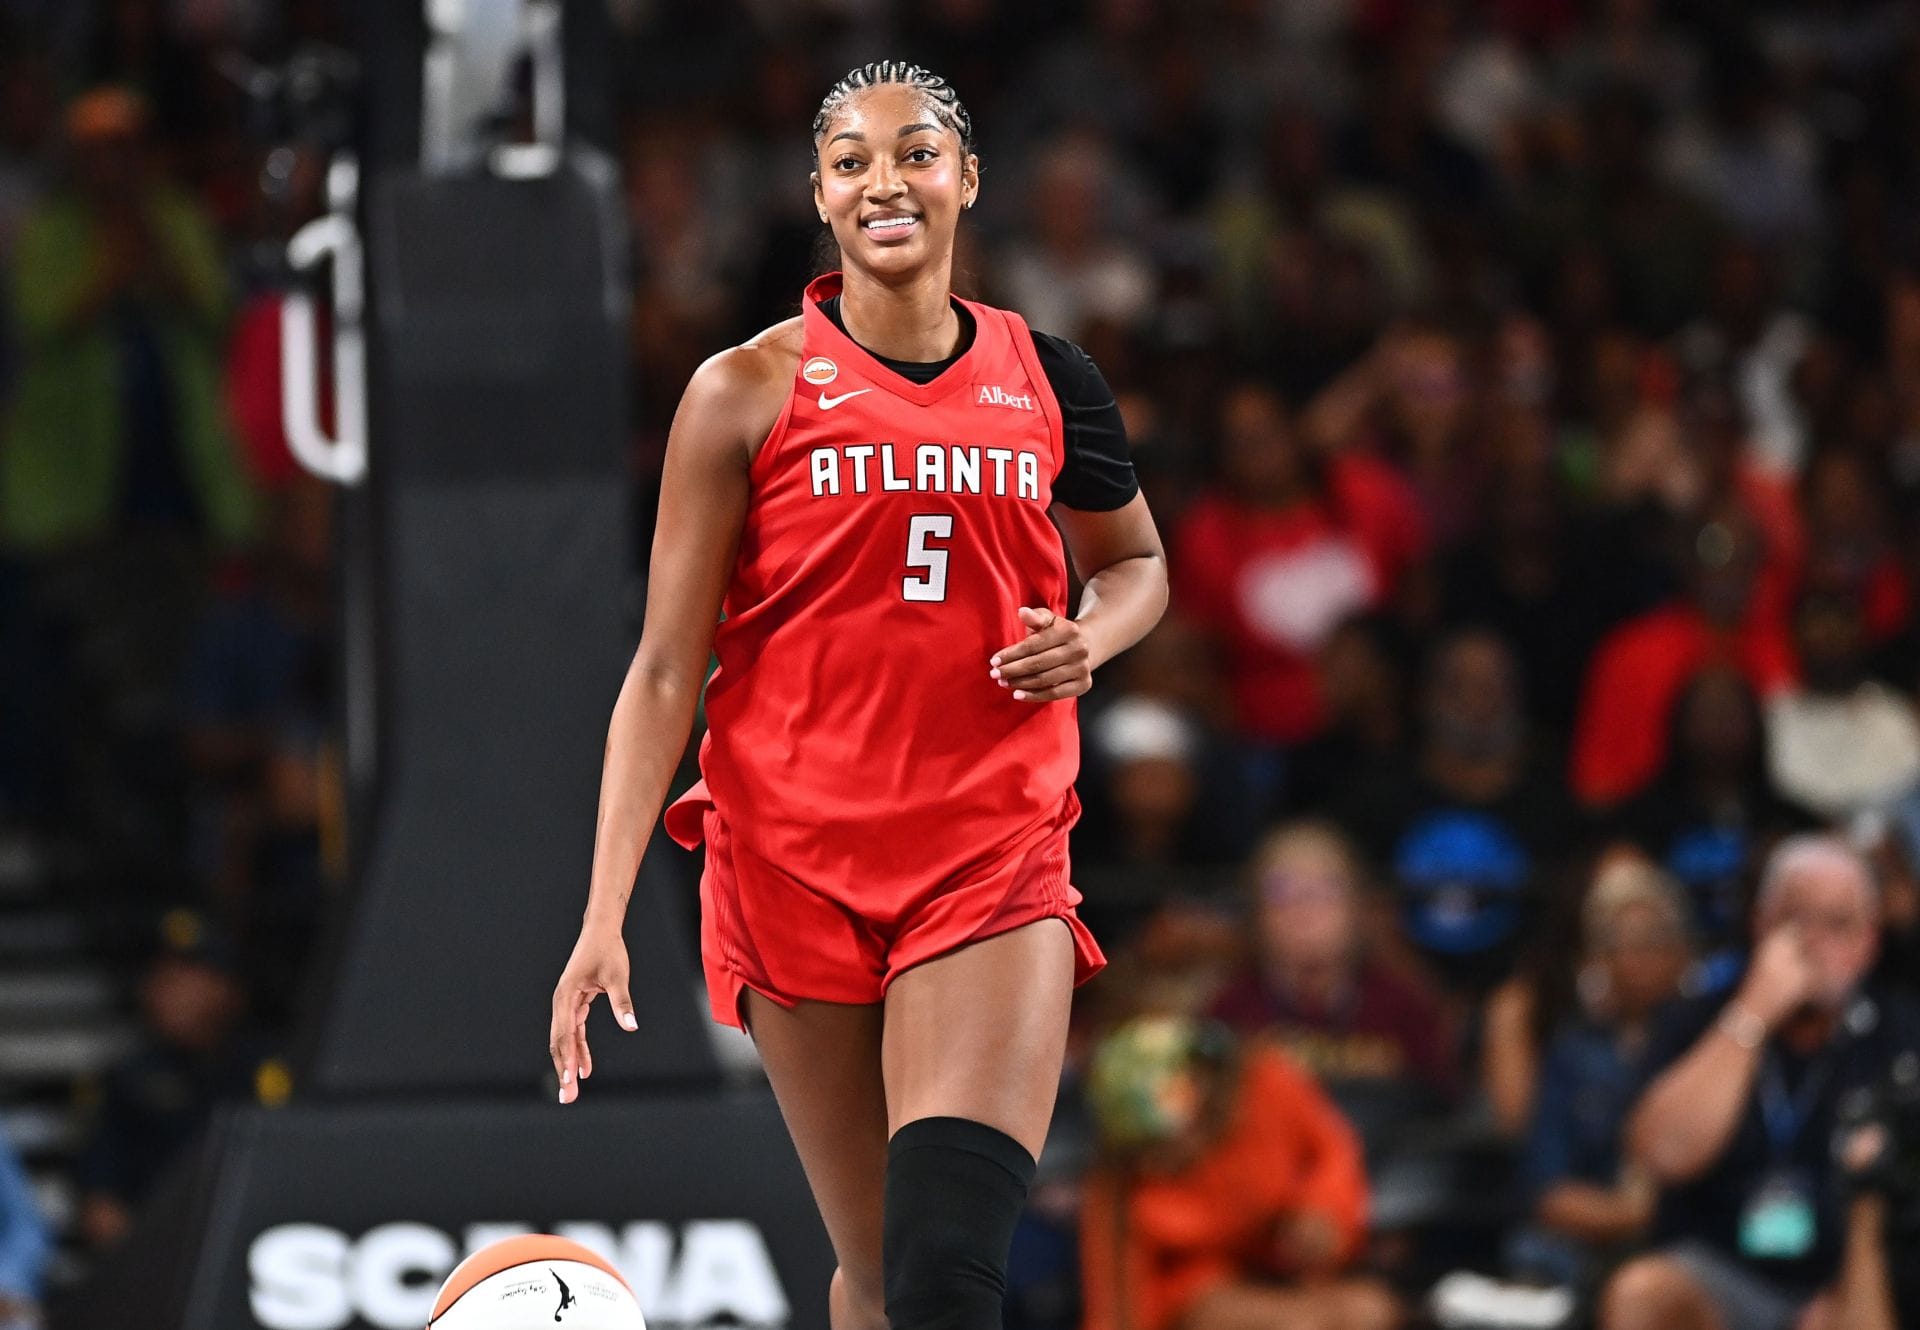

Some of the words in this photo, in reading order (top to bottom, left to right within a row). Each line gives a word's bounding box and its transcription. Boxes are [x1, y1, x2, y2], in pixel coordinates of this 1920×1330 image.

[978, 385, 1033, 410] Albert
[810, 443, 1040, 501] ATLANTA
[902, 514, 954, 602] 5
